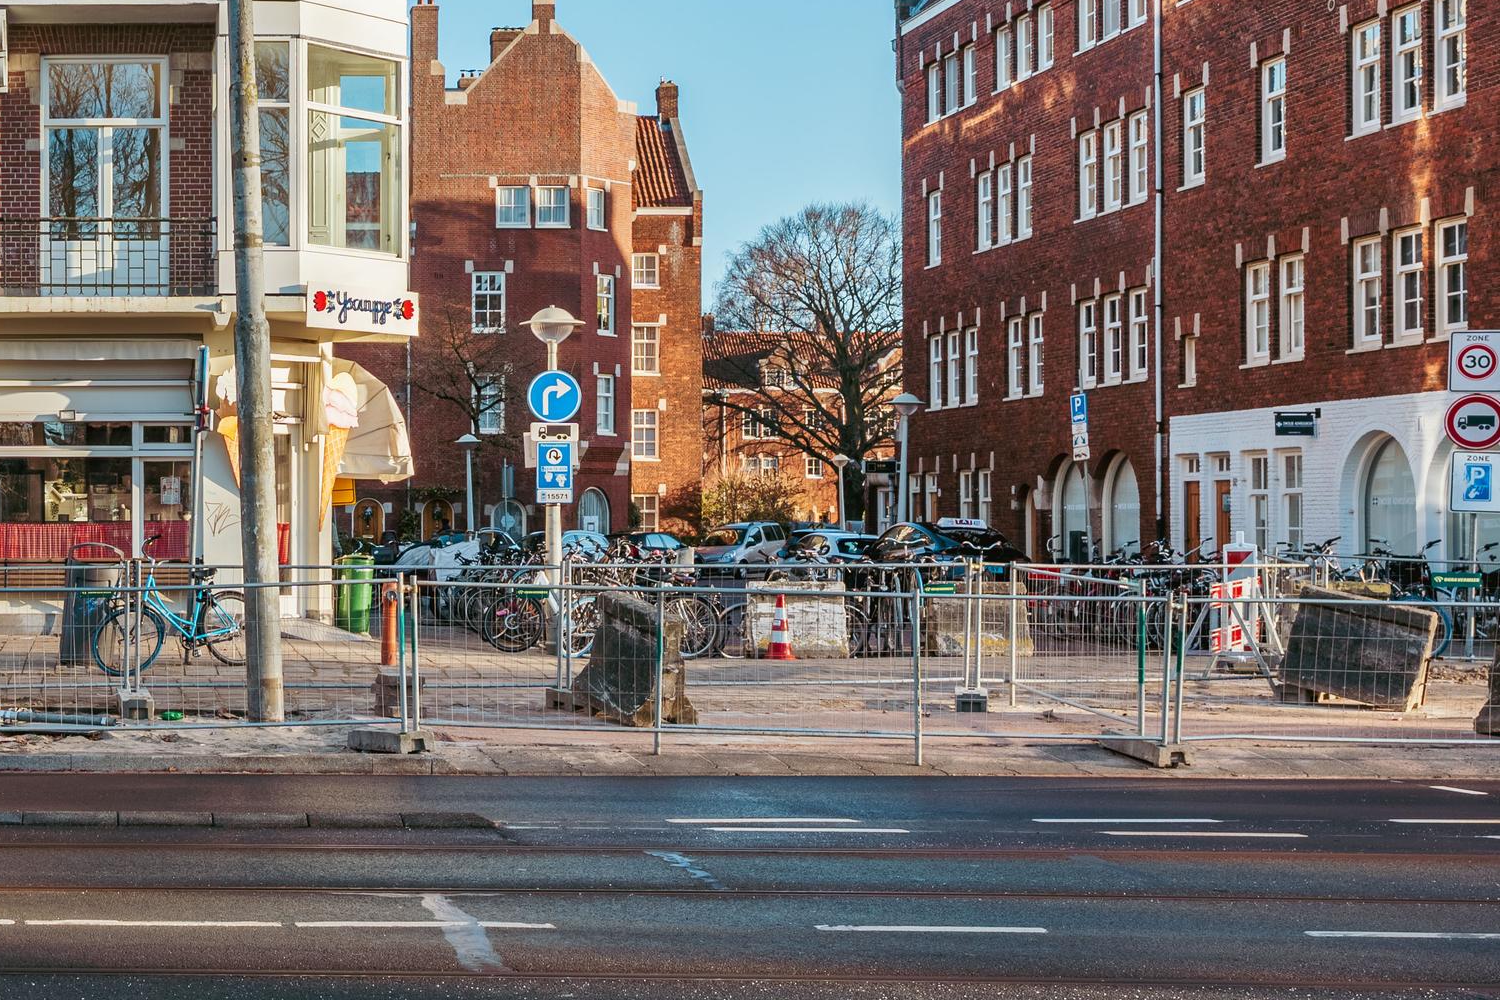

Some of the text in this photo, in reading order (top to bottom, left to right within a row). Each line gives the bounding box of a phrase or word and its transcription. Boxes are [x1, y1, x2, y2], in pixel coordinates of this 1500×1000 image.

[1465, 355, 1491, 369] 30
[1074, 397, 1081, 412] P
[1470, 467, 1485, 485] P
